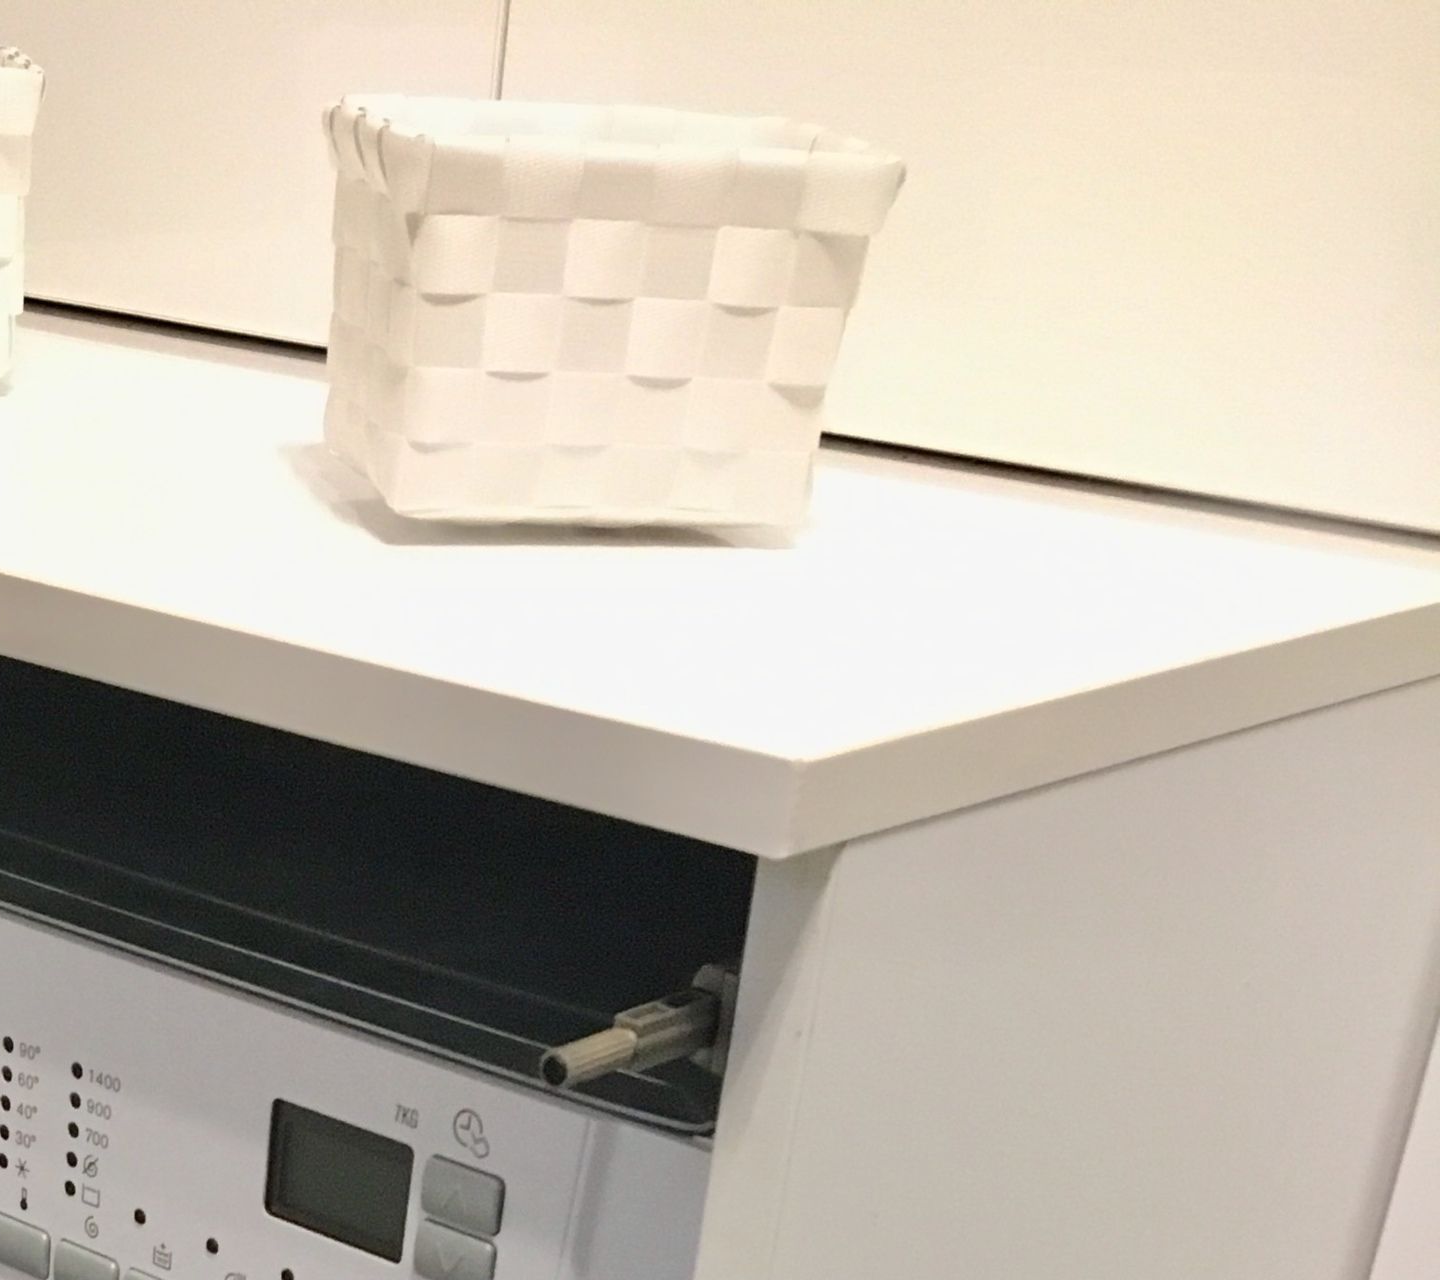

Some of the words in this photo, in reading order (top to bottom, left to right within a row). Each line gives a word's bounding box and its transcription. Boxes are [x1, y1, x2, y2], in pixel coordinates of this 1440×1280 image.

[88, 1069, 122, 1093] 1400
[86, 1098, 112, 1121] 900
[85, 1128, 109, 1149] 700
